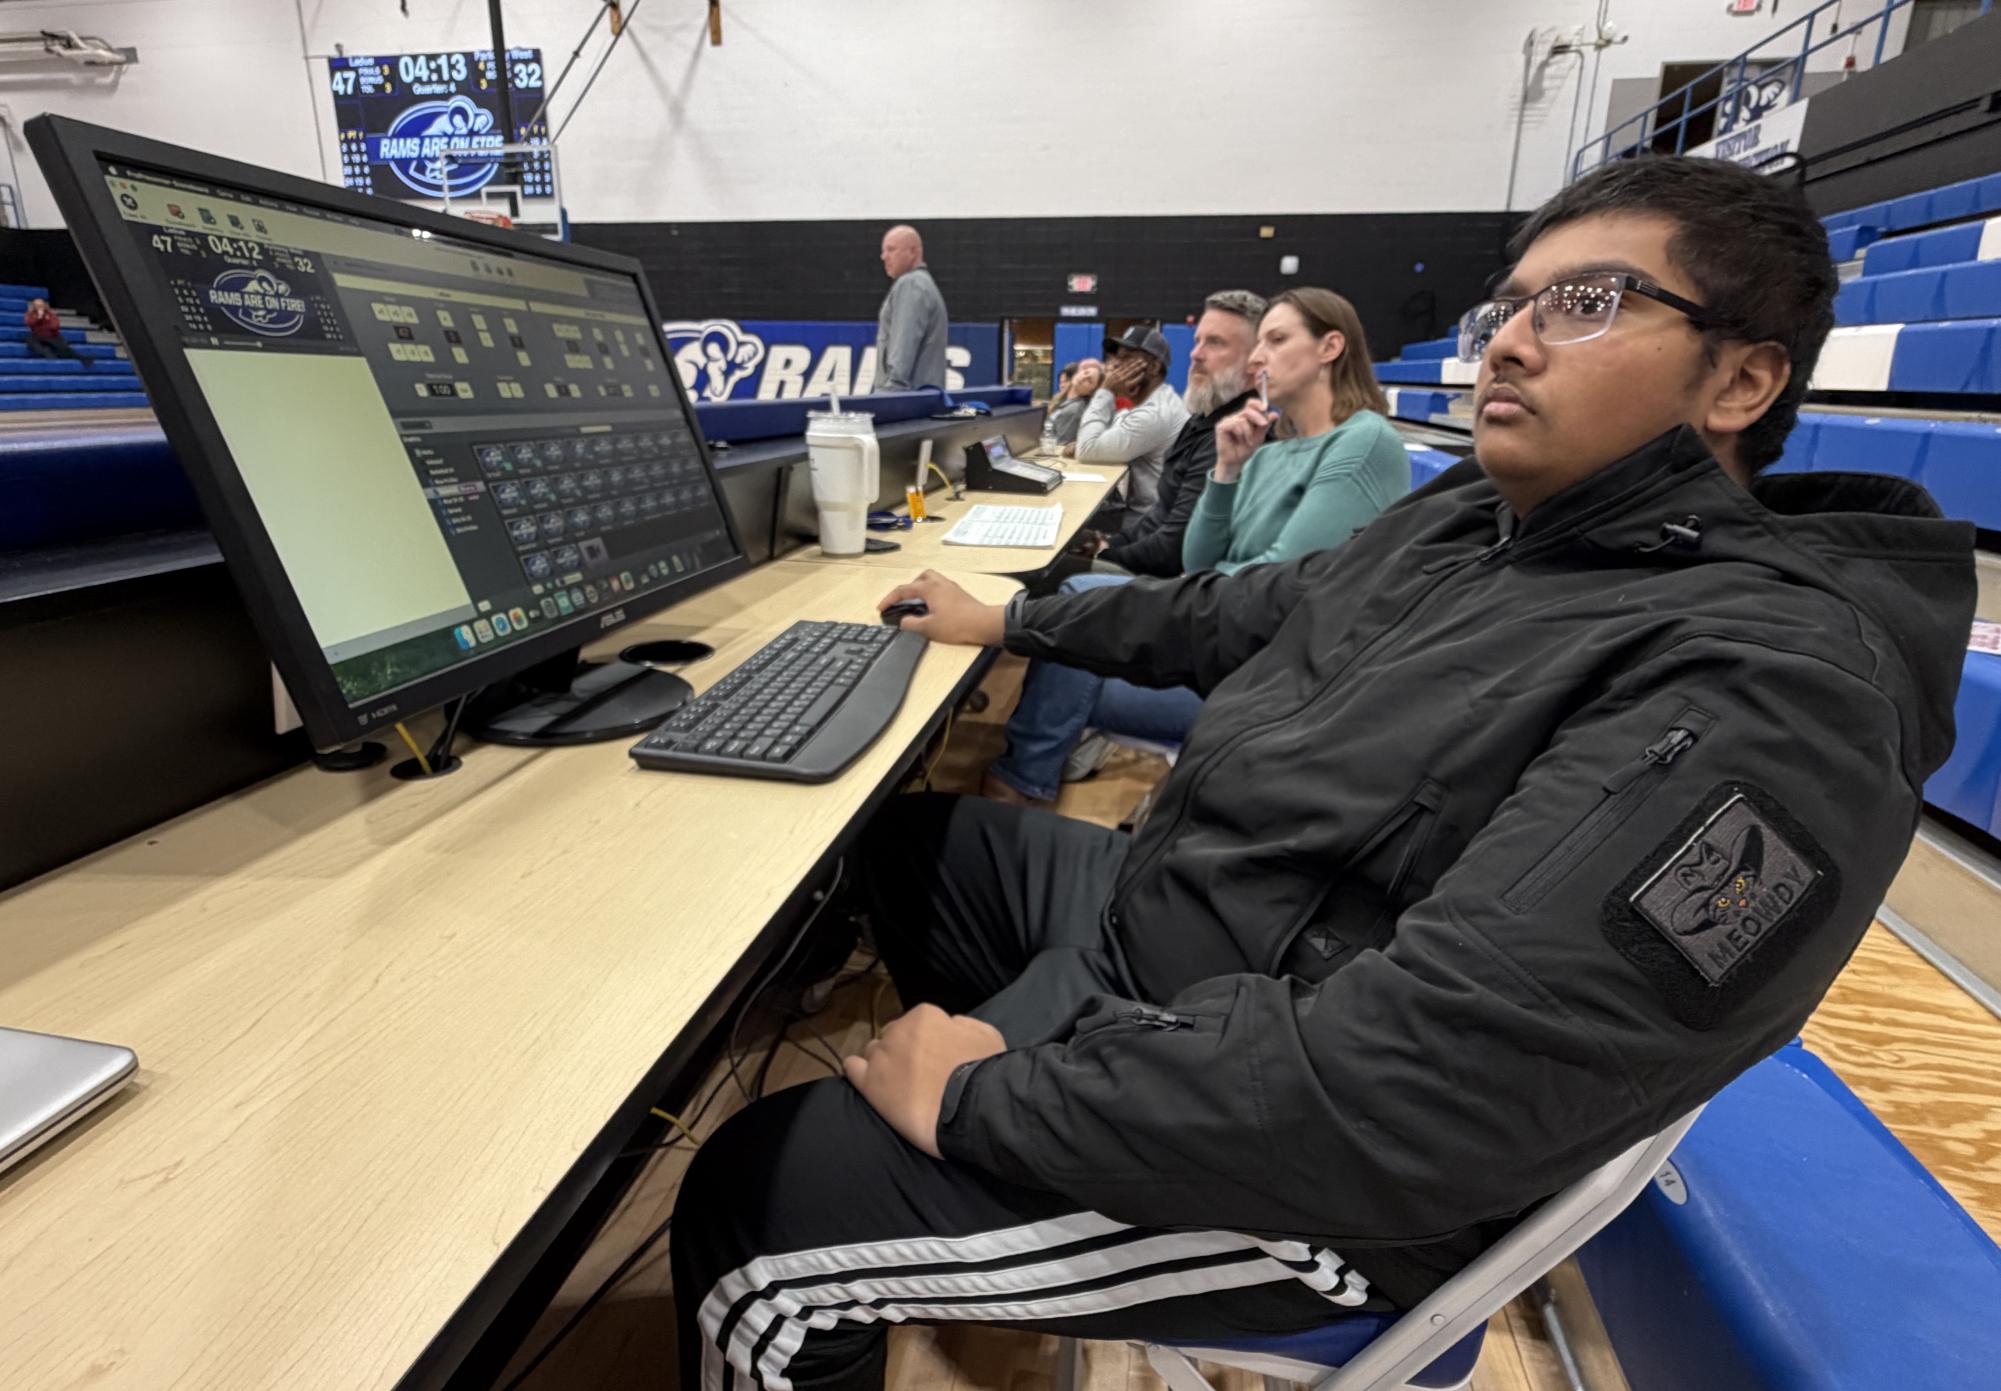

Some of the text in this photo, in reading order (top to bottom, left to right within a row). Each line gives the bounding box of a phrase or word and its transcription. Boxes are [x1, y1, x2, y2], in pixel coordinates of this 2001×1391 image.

[399, 53, 468, 83] 04:13
[514, 61, 543, 89] 32
[332, 70, 357, 95] 47
[380, 137, 420, 160] RAMS
[421, 136, 449, 158] ARE
[152, 234, 173, 253] 47
[207, 234, 264, 260] 04:12
[294, 256, 316, 274] 32
[208, 289, 242, 307] RAMS
[243, 293, 265, 309] ARE
[264, 295, 280, 311] ON
[600, 609, 626, 629] ASUS
[1706, 863, 1806, 971] MEOWDY
